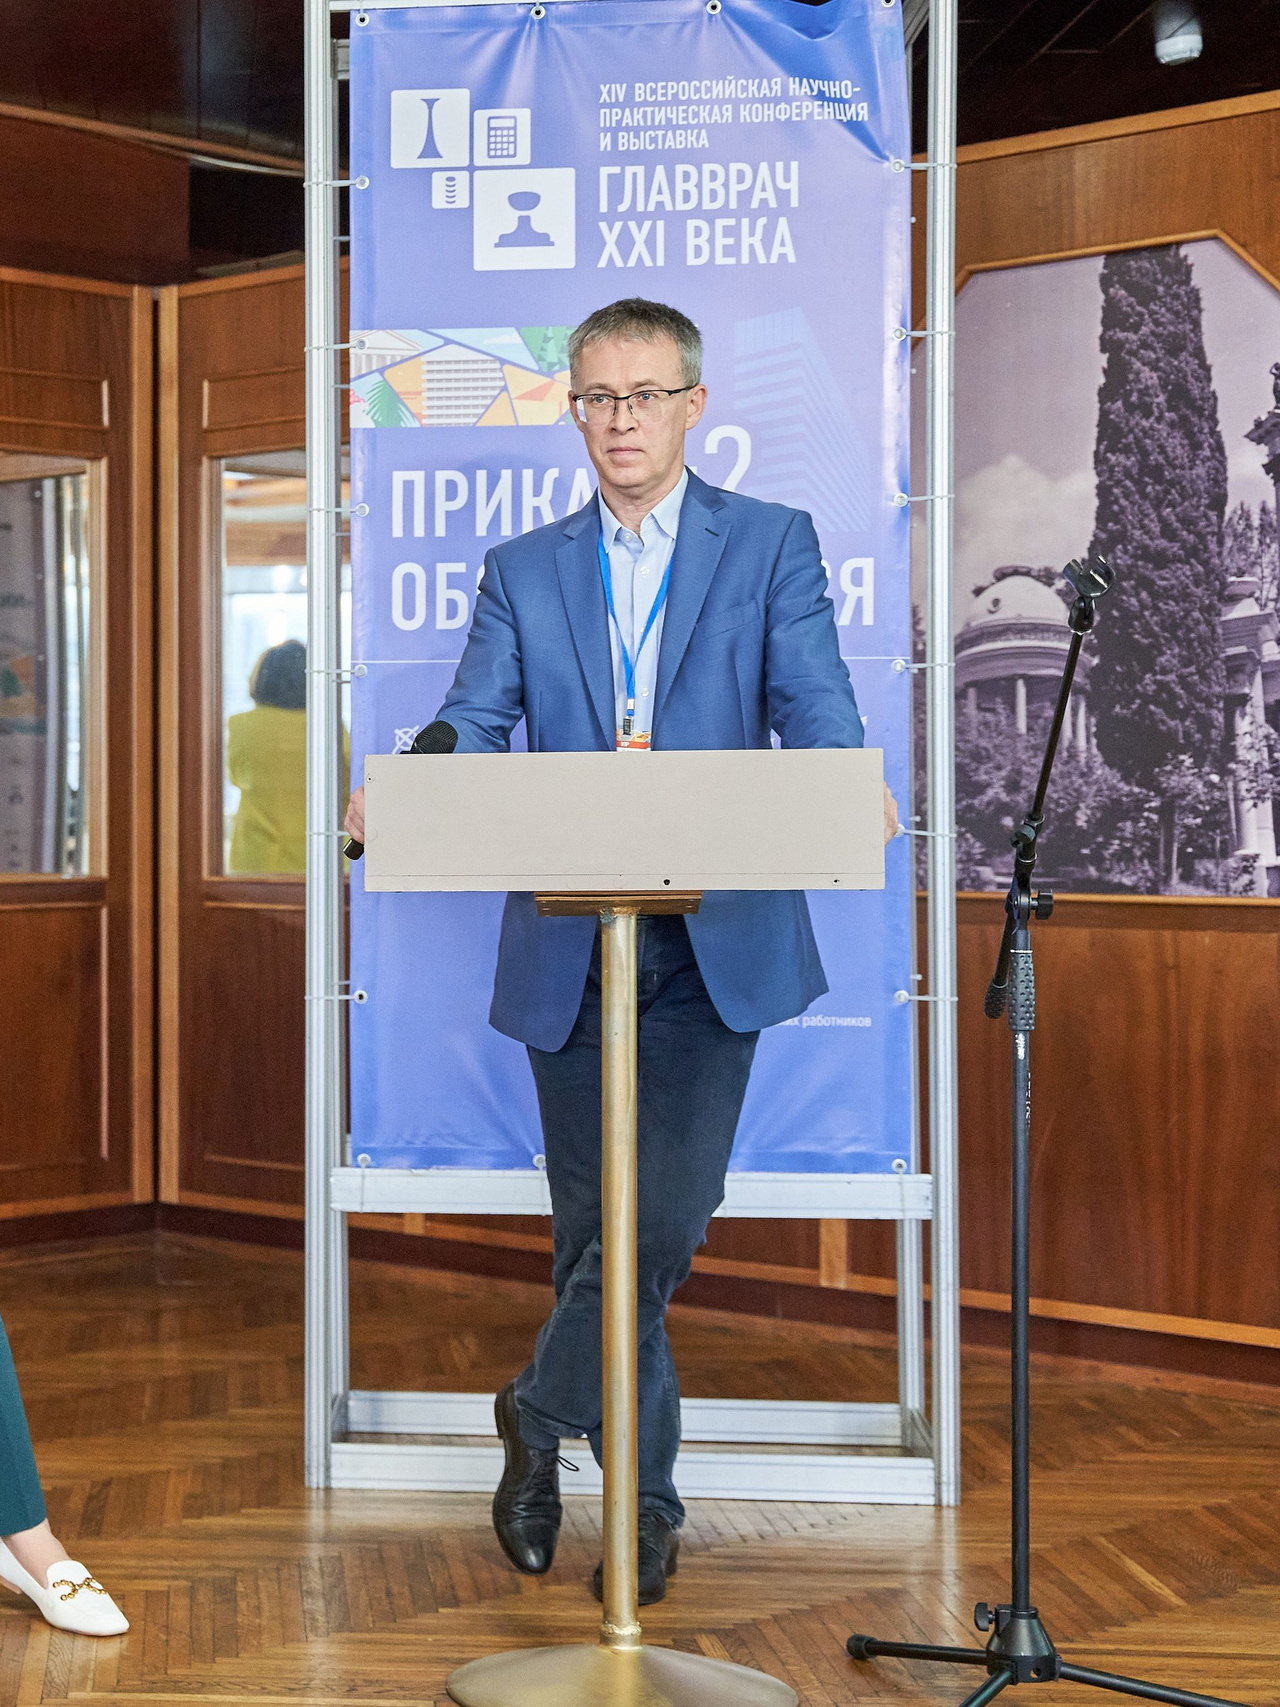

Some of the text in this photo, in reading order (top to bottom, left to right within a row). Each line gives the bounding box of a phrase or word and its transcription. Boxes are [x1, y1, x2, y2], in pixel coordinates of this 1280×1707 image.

[599, 76, 861, 103] XIV ВСЕРОССИЙСКАЯ НАУЧНО-
[599, 101, 869, 128] ПРАКТИЧЕСКАЯ КОНФЕРЕНЦИЯ
[599, 129, 710, 151] И ВЫСТАВКА
[599, 160, 799, 213] ГЛАВВРАЧ
[597, 216, 797, 268] XXI ВЕКА
[802, 1014, 872, 1029] работников
